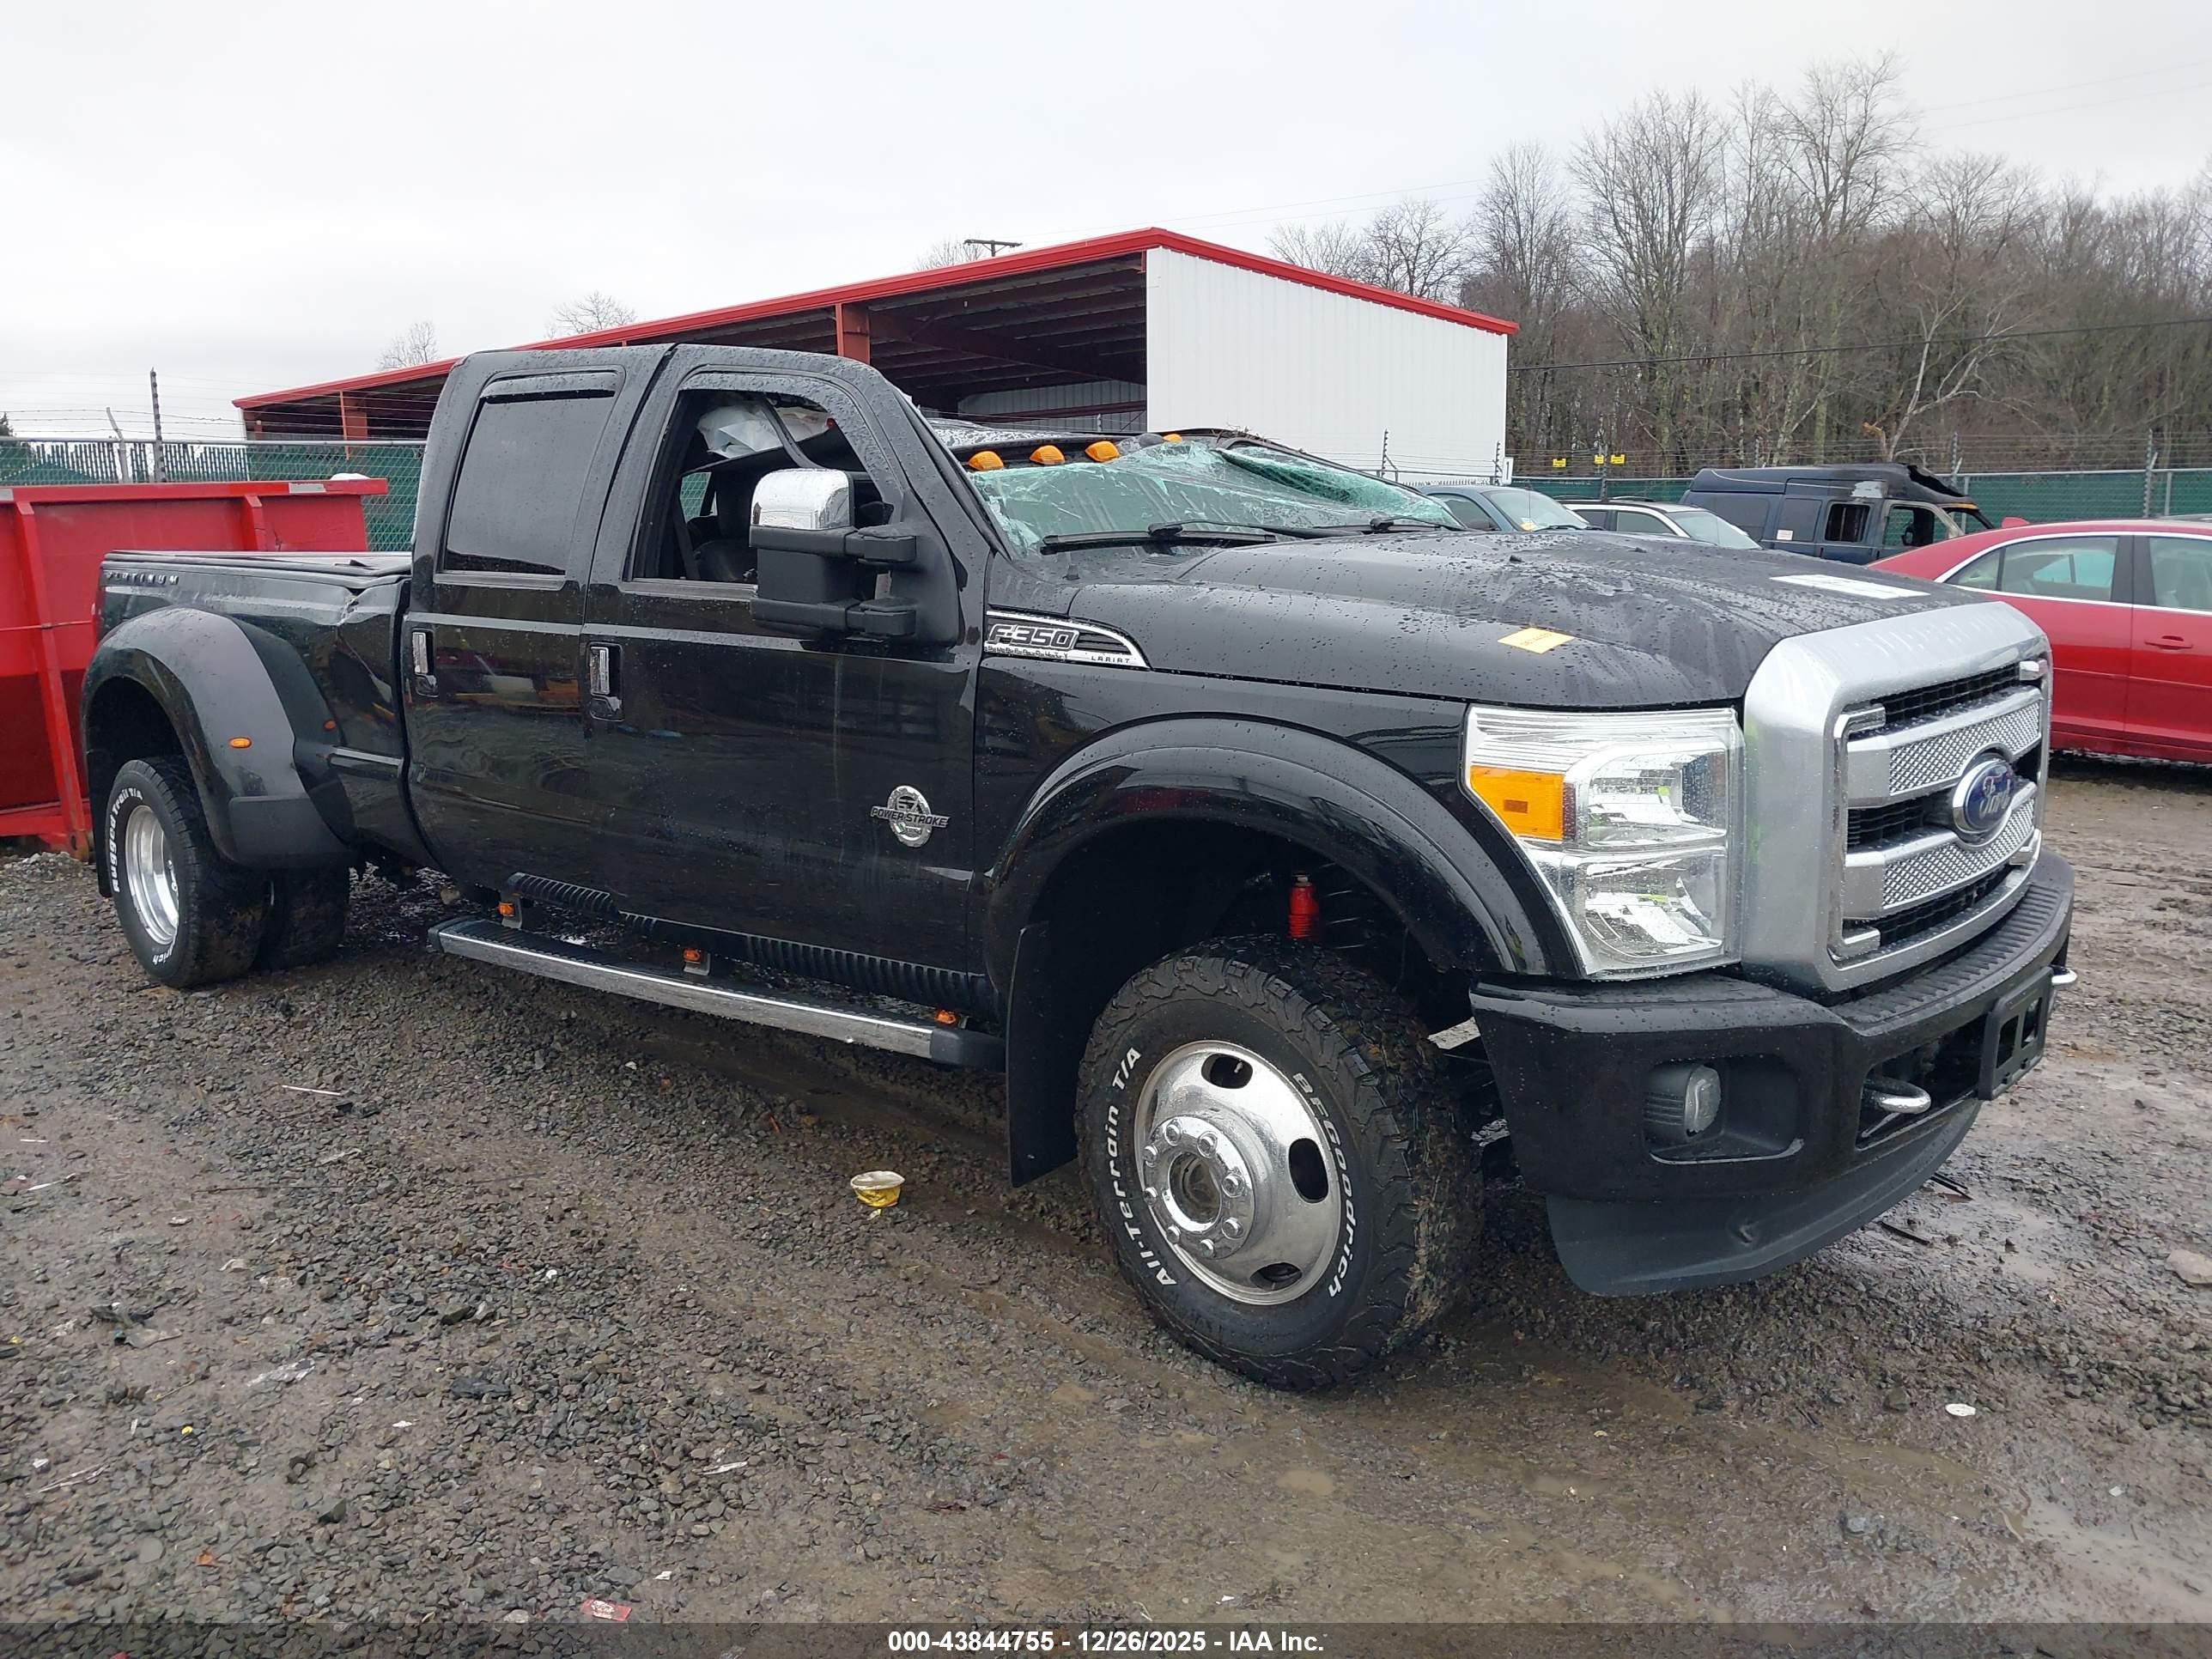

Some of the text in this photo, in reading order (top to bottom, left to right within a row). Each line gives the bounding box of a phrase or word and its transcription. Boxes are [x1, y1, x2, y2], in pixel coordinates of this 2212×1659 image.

[1091, 655, 1132, 664] LARIAT
[1978, 772, 2011, 820] Ford
[1112, 1046, 1143, 1091] T/A
[1291, 1072, 1358, 1297] BFGoodrich
